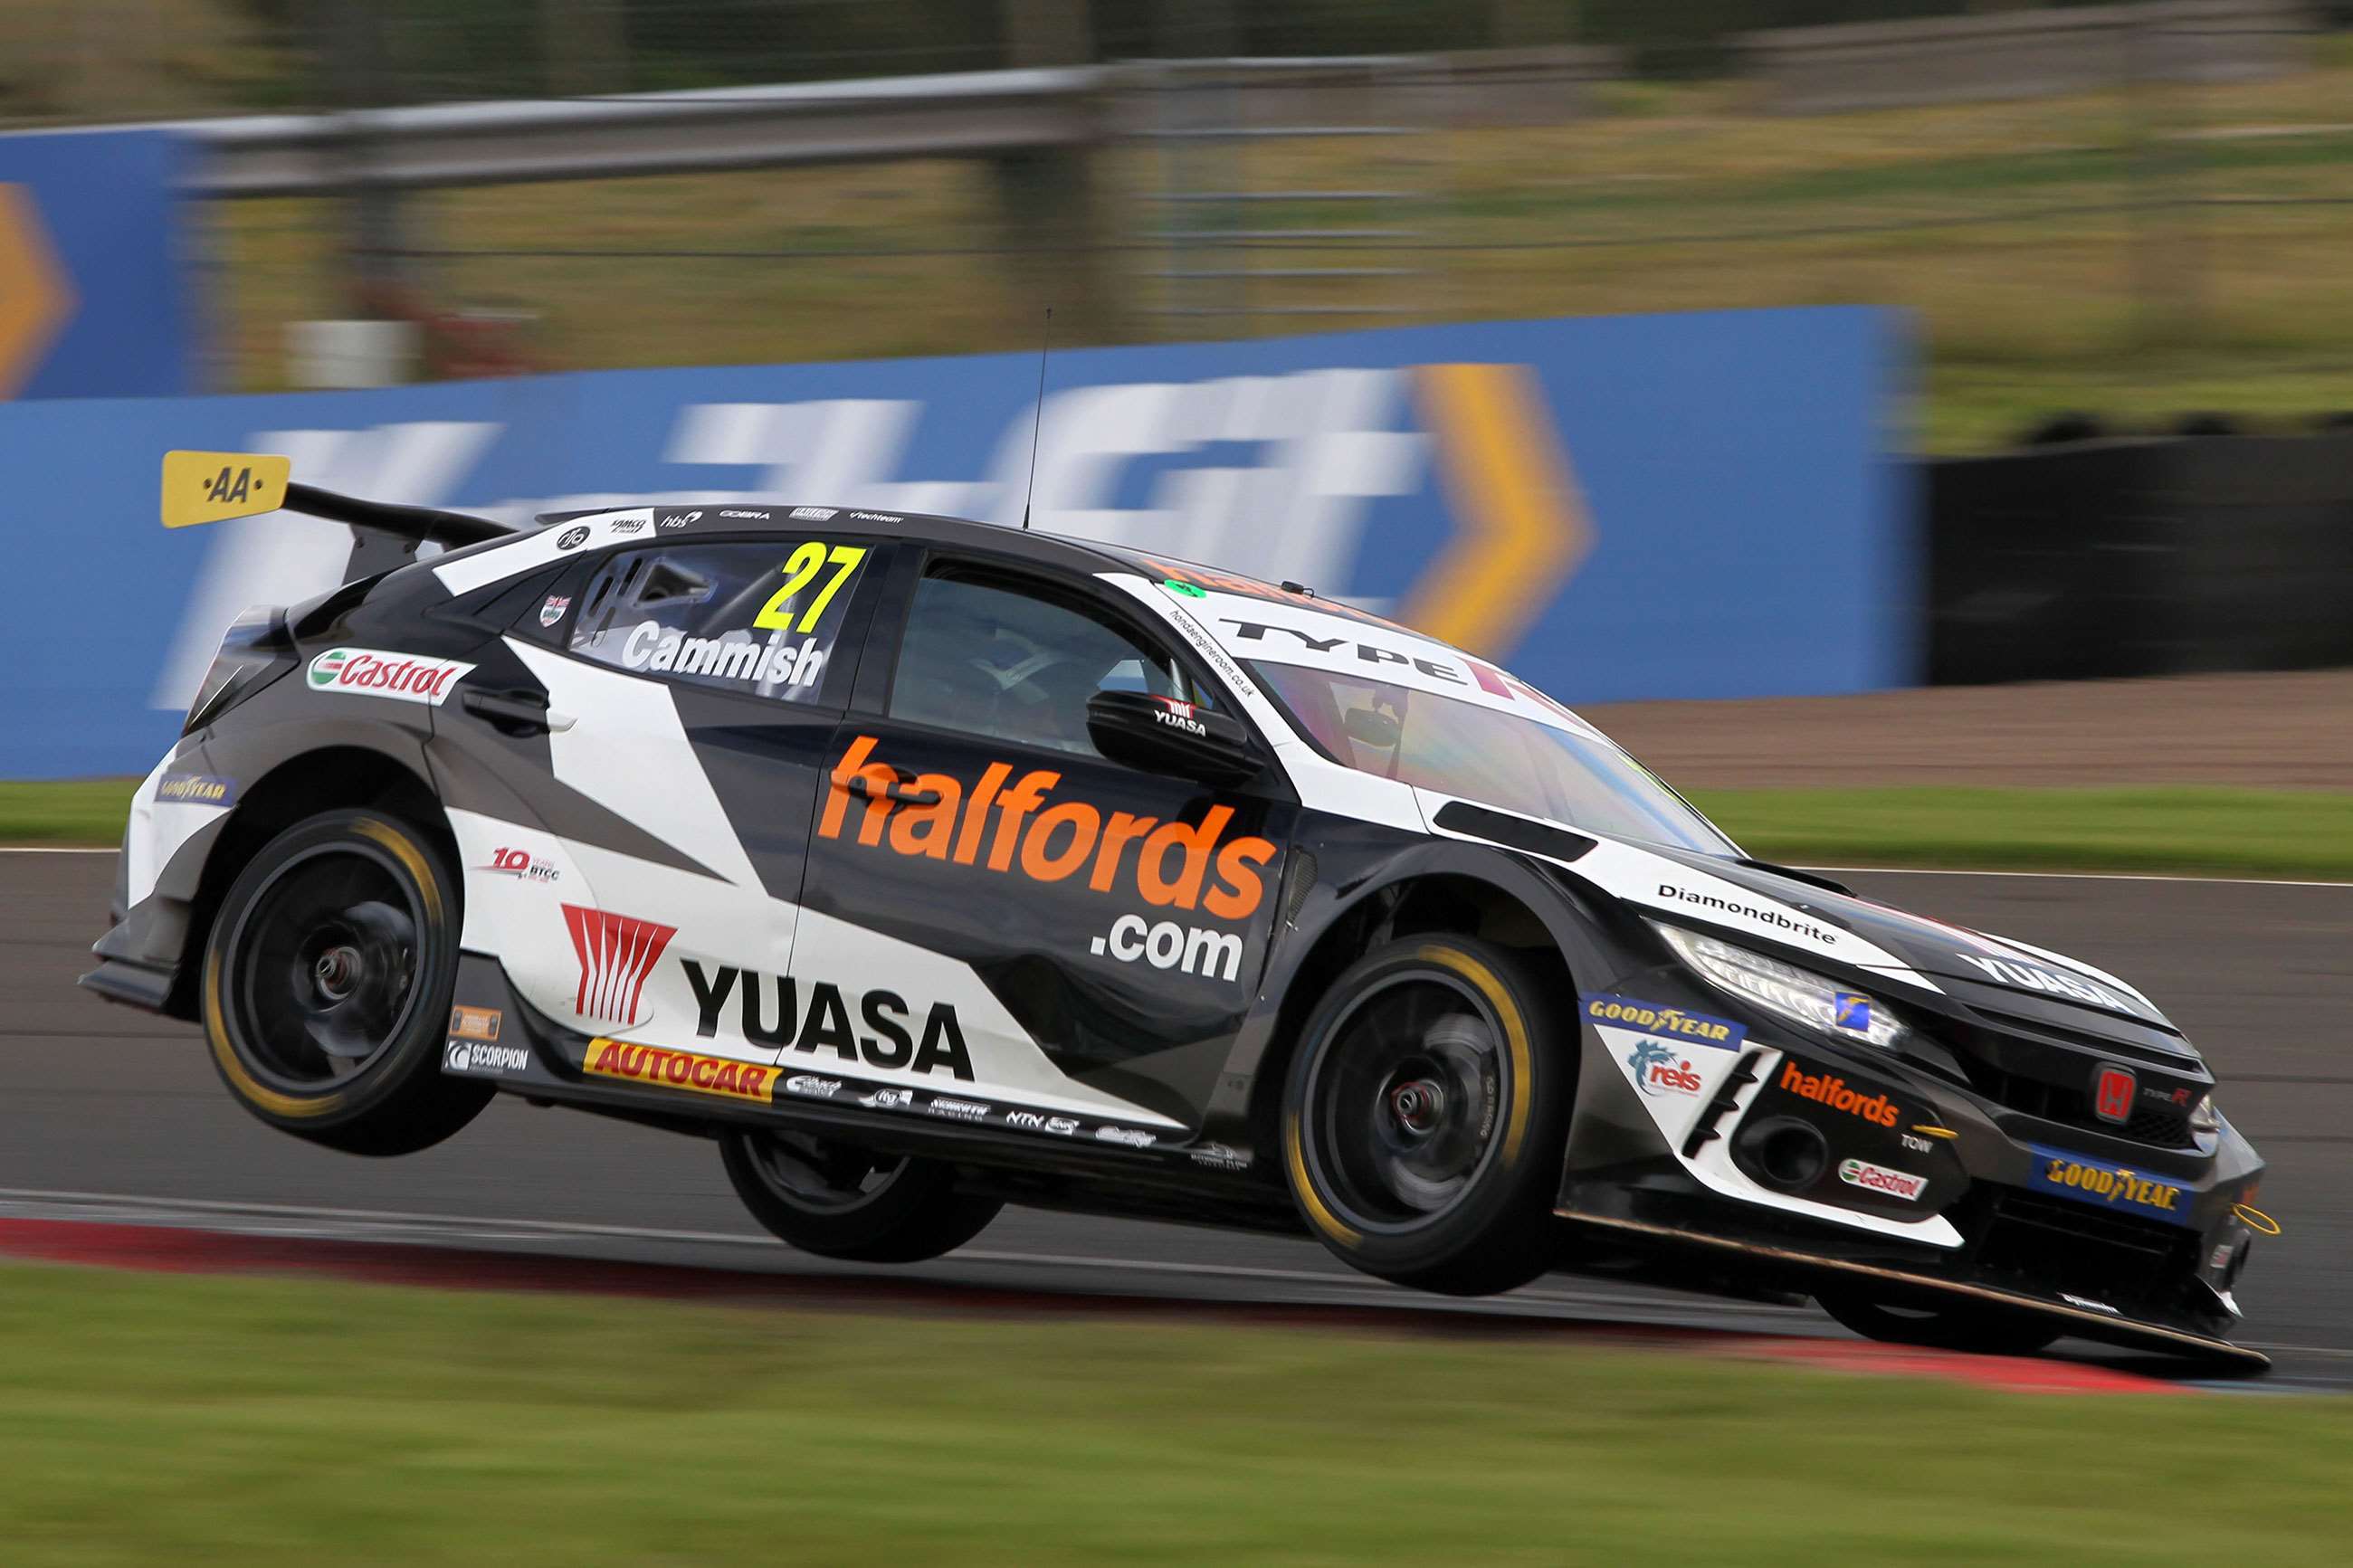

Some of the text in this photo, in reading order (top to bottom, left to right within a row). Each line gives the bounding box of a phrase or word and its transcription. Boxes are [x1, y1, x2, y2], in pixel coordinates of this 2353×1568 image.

[207, 467, 252, 502] AA
[719, 510, 770, 519] COBRA
[753, 542, 867, 633] 27
[340, 655, 455, 697] Castrol
[622, 620, 824, 687] Cammish
[1170, 610, 1255, 698] hondaengineroom.co.uk
[1219, 618, 1470, 685] TYPE
[1155, 709, 1206, 737] YUASA
[818, 736, 1278, 919] halfords
[492, 847, 531, 870] 10
[1658, 884, 1835, 945] Diamondbrite
[1091, 914, 1243, 983] .com
[1956, 953, 2139, 1017] YUASA
[680, 957, 975, 1083] YUASA
[1589, 999, 1730, 1042] GOODYEAR
[472, 1044, 529, 1070] SCORPION
[595, 1039, 768, 1097] AUTOCAR
[1650, 1060, 1701, 1091] reis
[1006, 1111, 1044, 1127] NTN
[1780, 1062, 1900, 1127] halfords
[1900, 1134, 1933, 1154] TOW
[1859, 1167, 1920, 1196] Castrol
